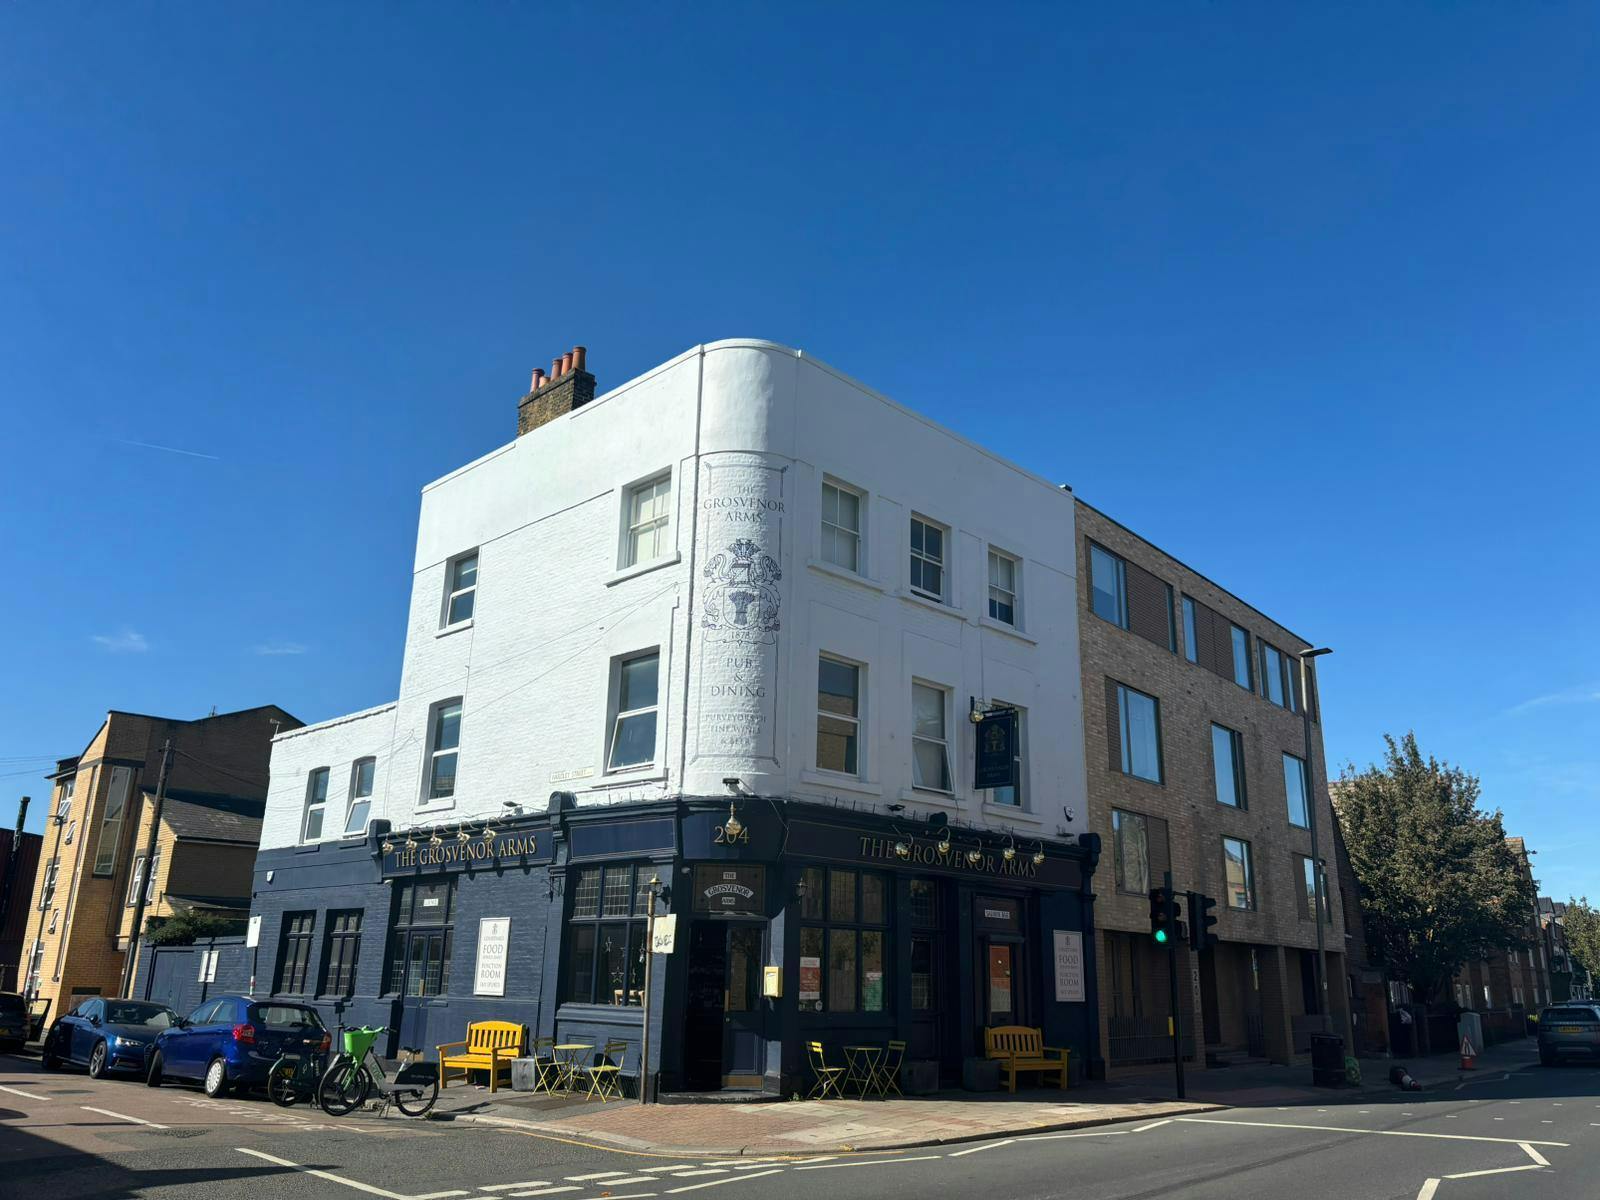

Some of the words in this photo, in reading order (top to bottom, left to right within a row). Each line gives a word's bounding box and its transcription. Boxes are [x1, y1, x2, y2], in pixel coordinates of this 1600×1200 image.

[737, 486, 754, 495] THE
[703, 497, 785, 513] GROSVENOR
[725, 511, 762, 523] ARMS
[731, 631, 750, 640] 1878
[727, 658, 753, 668] PUB
[734, 671, 743, 682] &
[711, 686, 766, 698] DINING
[705, 713, 754, 723] PURVEYORS
[714, 826, 751, 844] 204
[395, 851, 416, 868] THE
[419, 841, 495, 865] GROSVENOR
[498, 835, 536, 857] ARMS
[859, 837, 894, 859] THE
[1000, 854, 1037, 878] ARMS
[707, 884, 750, 897] GROSVENOR
[483, 944, 504, 954] FOOD
[1058, 953, 1079, 965] FOOD
[480, 970, 501, 979] ROOM
